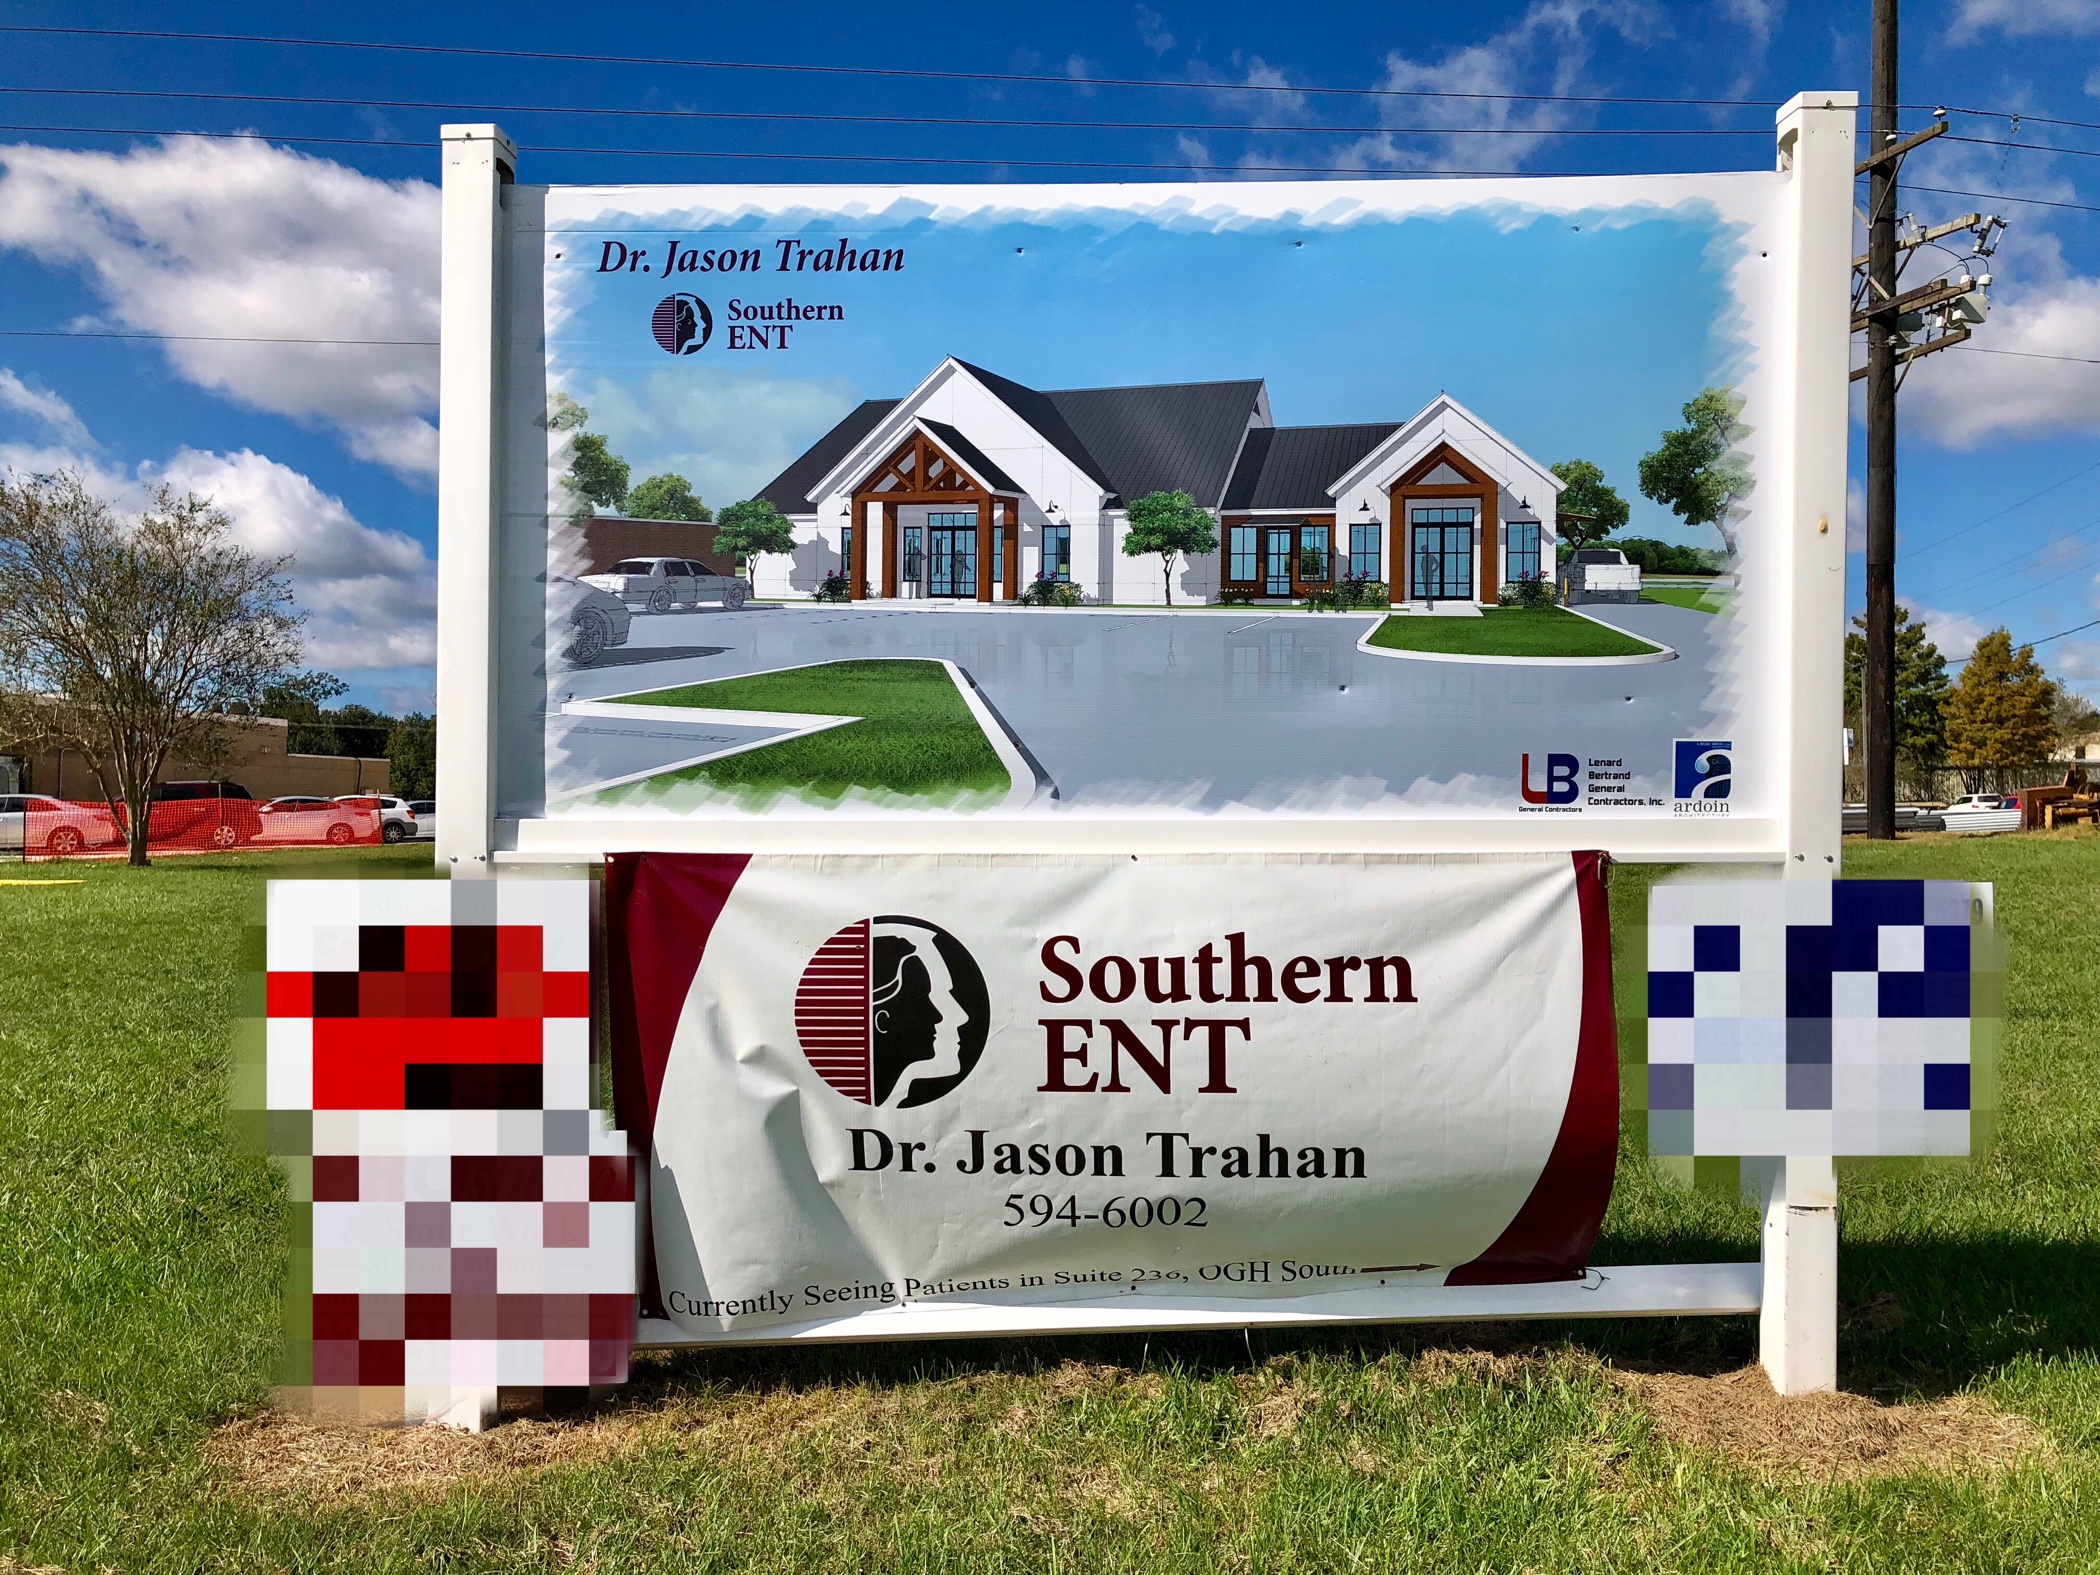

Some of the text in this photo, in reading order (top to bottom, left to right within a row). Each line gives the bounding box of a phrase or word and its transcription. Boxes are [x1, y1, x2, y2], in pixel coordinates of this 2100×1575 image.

[596, 238, 905, 279] Dr. Jason Trahan
[727, 298, 844, 321] Southern
[727, 325, 793, 350] ENT
[1588, 758, 1622, 767] Lenard
[1588, 771, 1631, 780] Bertrand
[1588, 784, 1625, 793] General
[1588, 797, 1665, 807] Contractors, Inc.
[1673, 800, 1730, 812] ardoin
[1038, 932, 1418, 1004] Southern
[1037, 1017, 1251, 1094] ENT
[845, 1127, 1367, 1179] Dr. Jason Trahan
[1002, 1194, 1209, 1229] 594-6002
[668, 1289, 793, 1317] Currently
[804, 1280, 896, 1306] Seeing
[903, 1274, 1010, 1297] Patients
[1020, 1273, 1044, 1287] in
[1054, 1268, 1122, 1285] Suite
[1199, 1261, 1270, 1283] OGH
